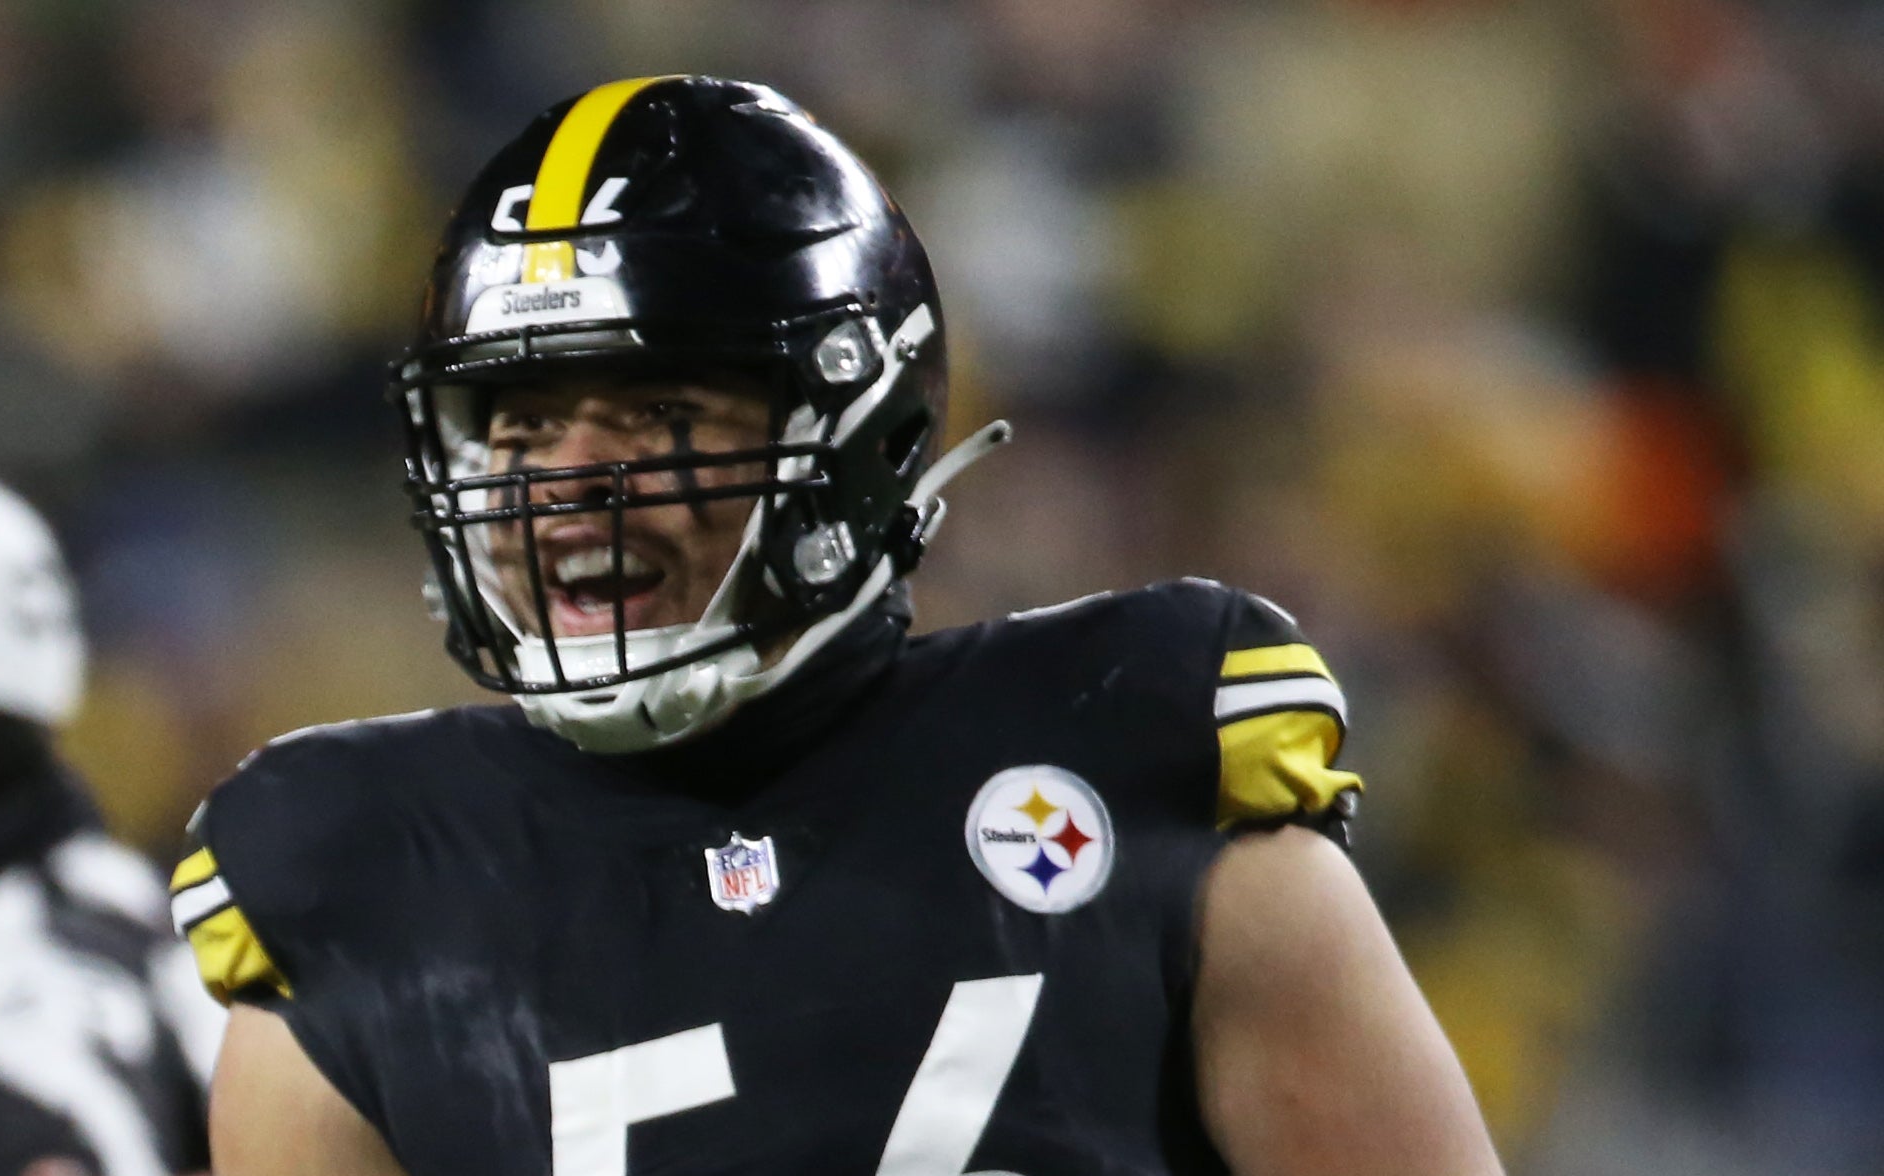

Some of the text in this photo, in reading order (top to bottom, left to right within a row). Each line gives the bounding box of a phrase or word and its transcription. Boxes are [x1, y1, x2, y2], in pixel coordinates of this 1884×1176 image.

[501, 285, 581, 316] Steelers
[981, 827, 1036, 844] Steelers
[721, 866, 768, 897] NFL
